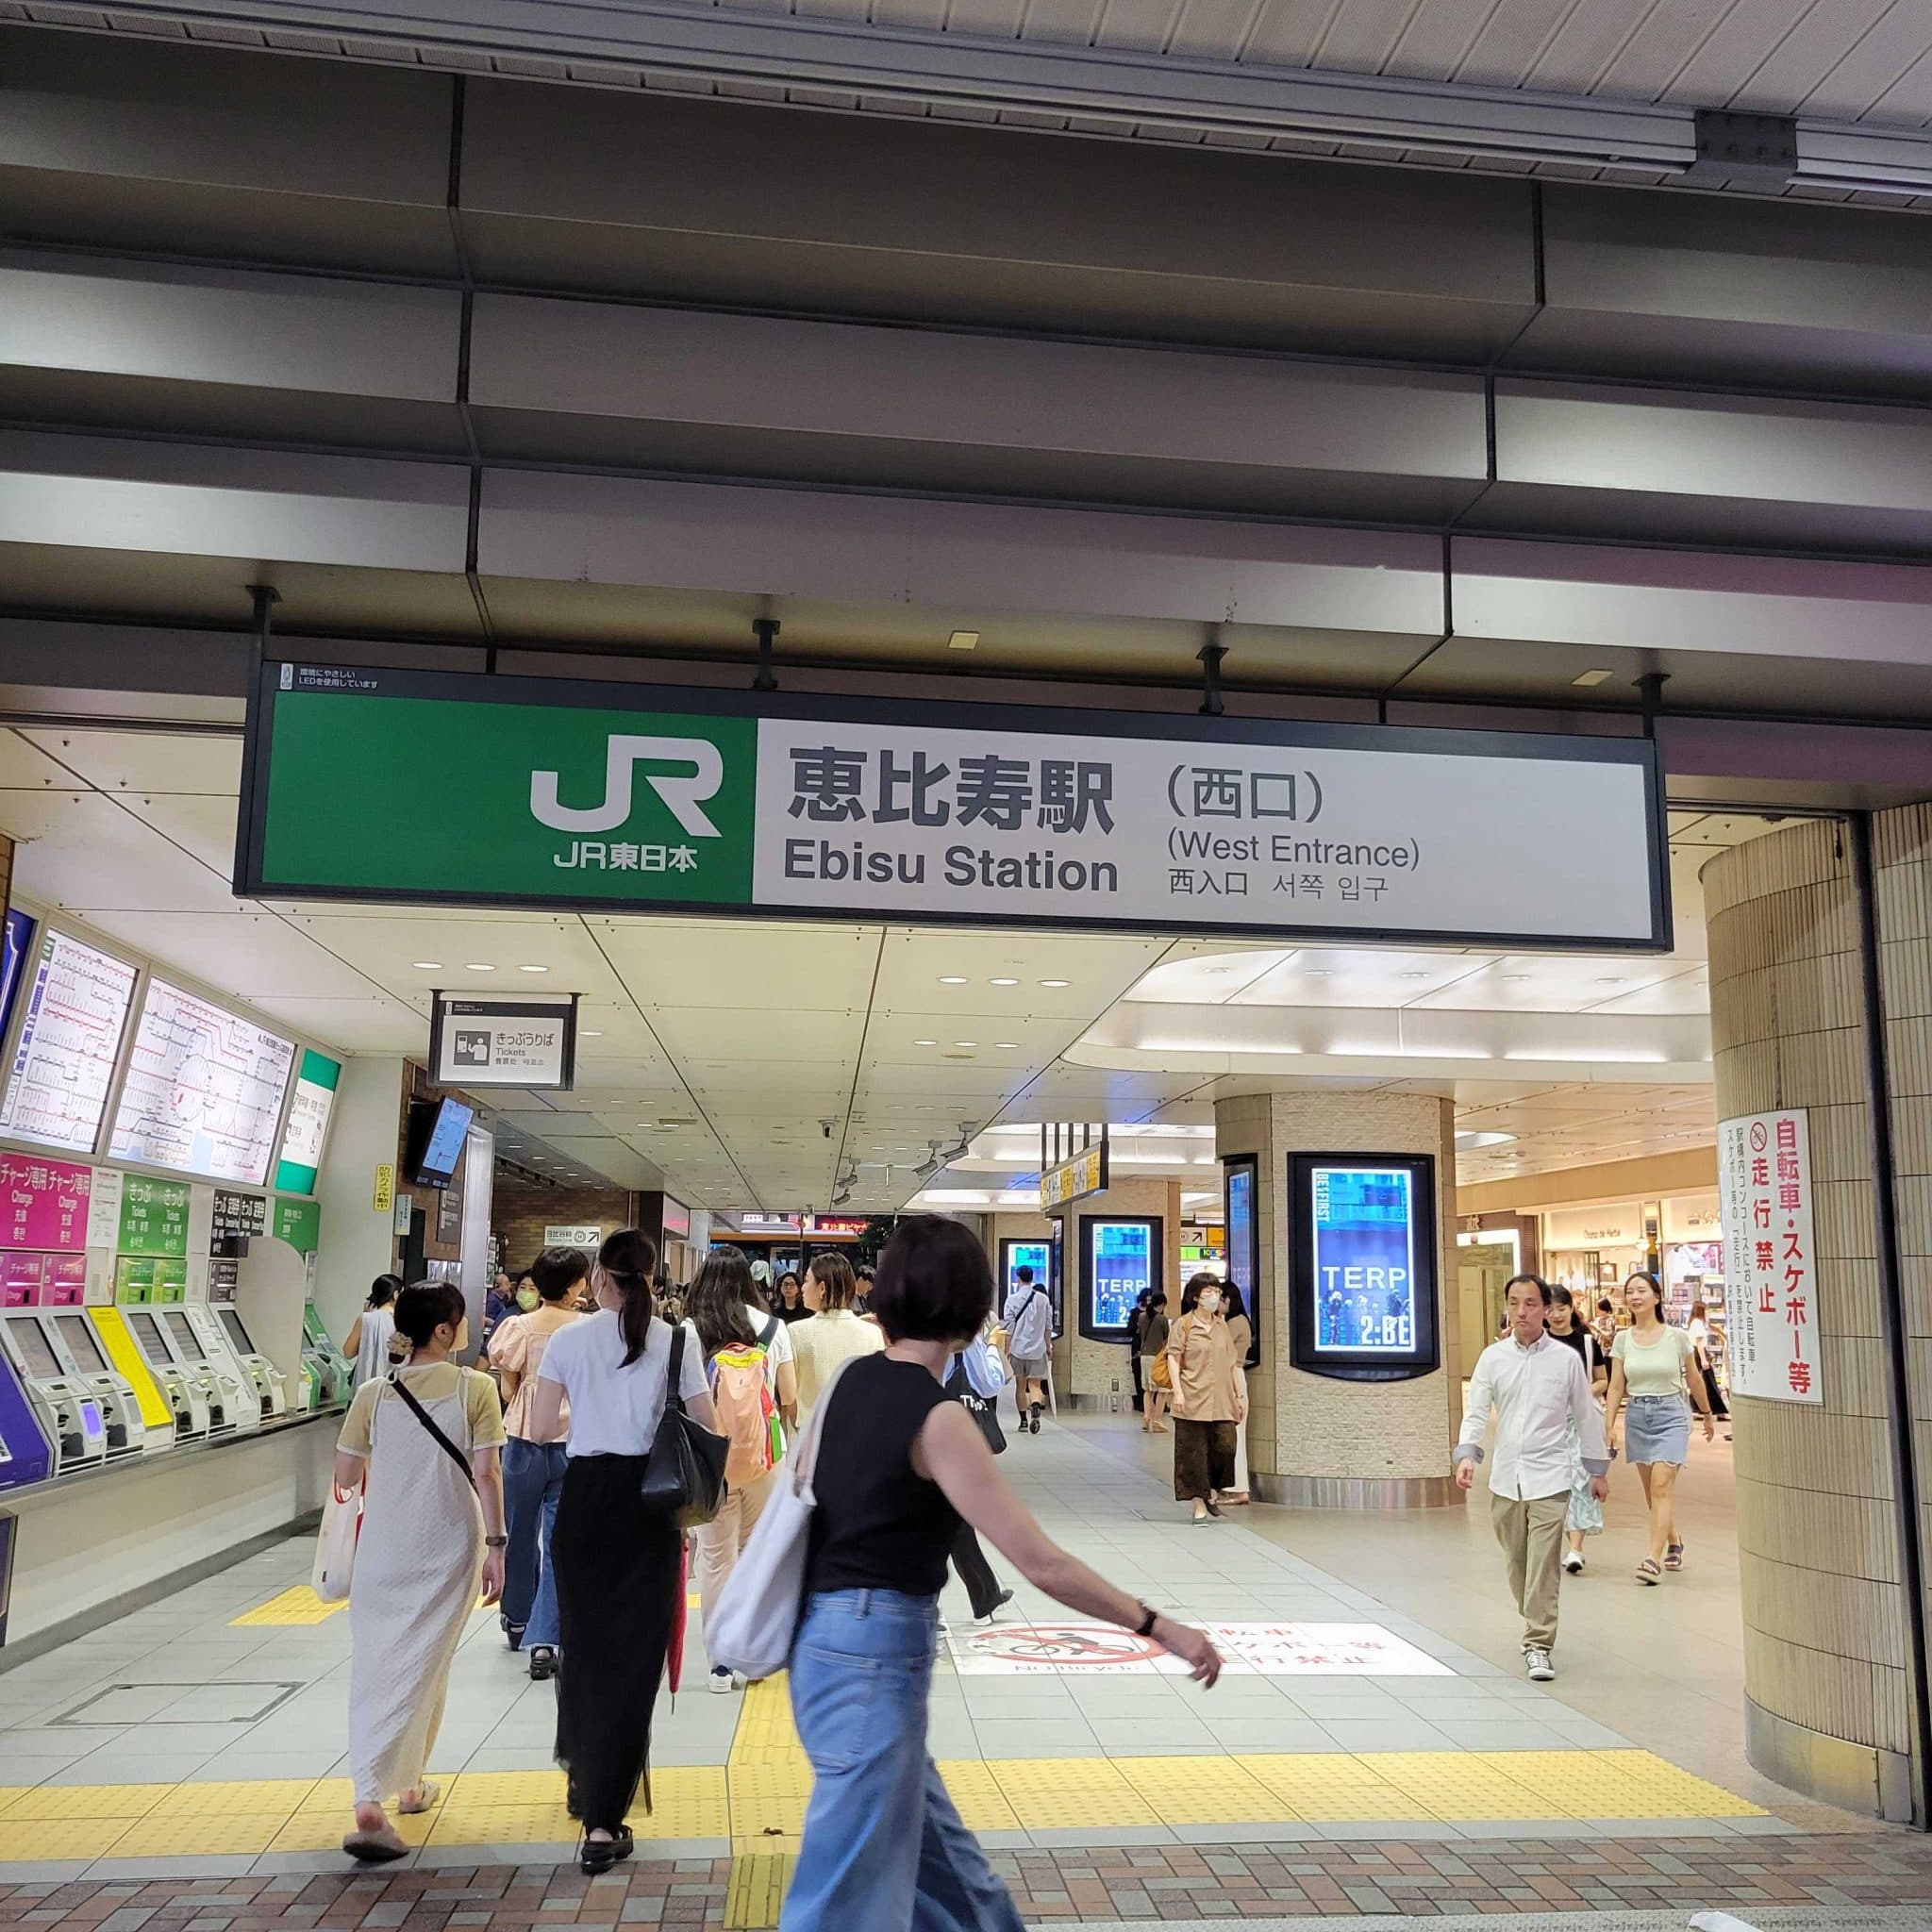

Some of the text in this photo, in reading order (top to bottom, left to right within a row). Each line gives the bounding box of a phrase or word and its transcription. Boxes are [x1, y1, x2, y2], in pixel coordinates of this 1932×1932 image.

[530, 733, 724, 838] JR
[787, 746, 1115, 836] 恵比寿駅
[553, 841, 698, 873] JR東日本
[1168, 826, 1420, 871] (West Entrance)
[784, 838, 1117, 892] Ebisu Station
[1168, 868, 1248, 895] 西入口
[1273, 873, 1389, 901] 서쪽 입구
[496, 1032, 555, 1047] きっぷうりば
[496, 1048, 526, 1057] Tickets
[129, 1183, 152, 1203] きっぷ
[1751, 1158, 1776, 1313] 走行禁止
[1776, 1119, 1811, 1394] 自転車・スケボー等
[1098, 1278, 1146, 1293] TERP
[1323, 1267, 1407, 1289] TERP
